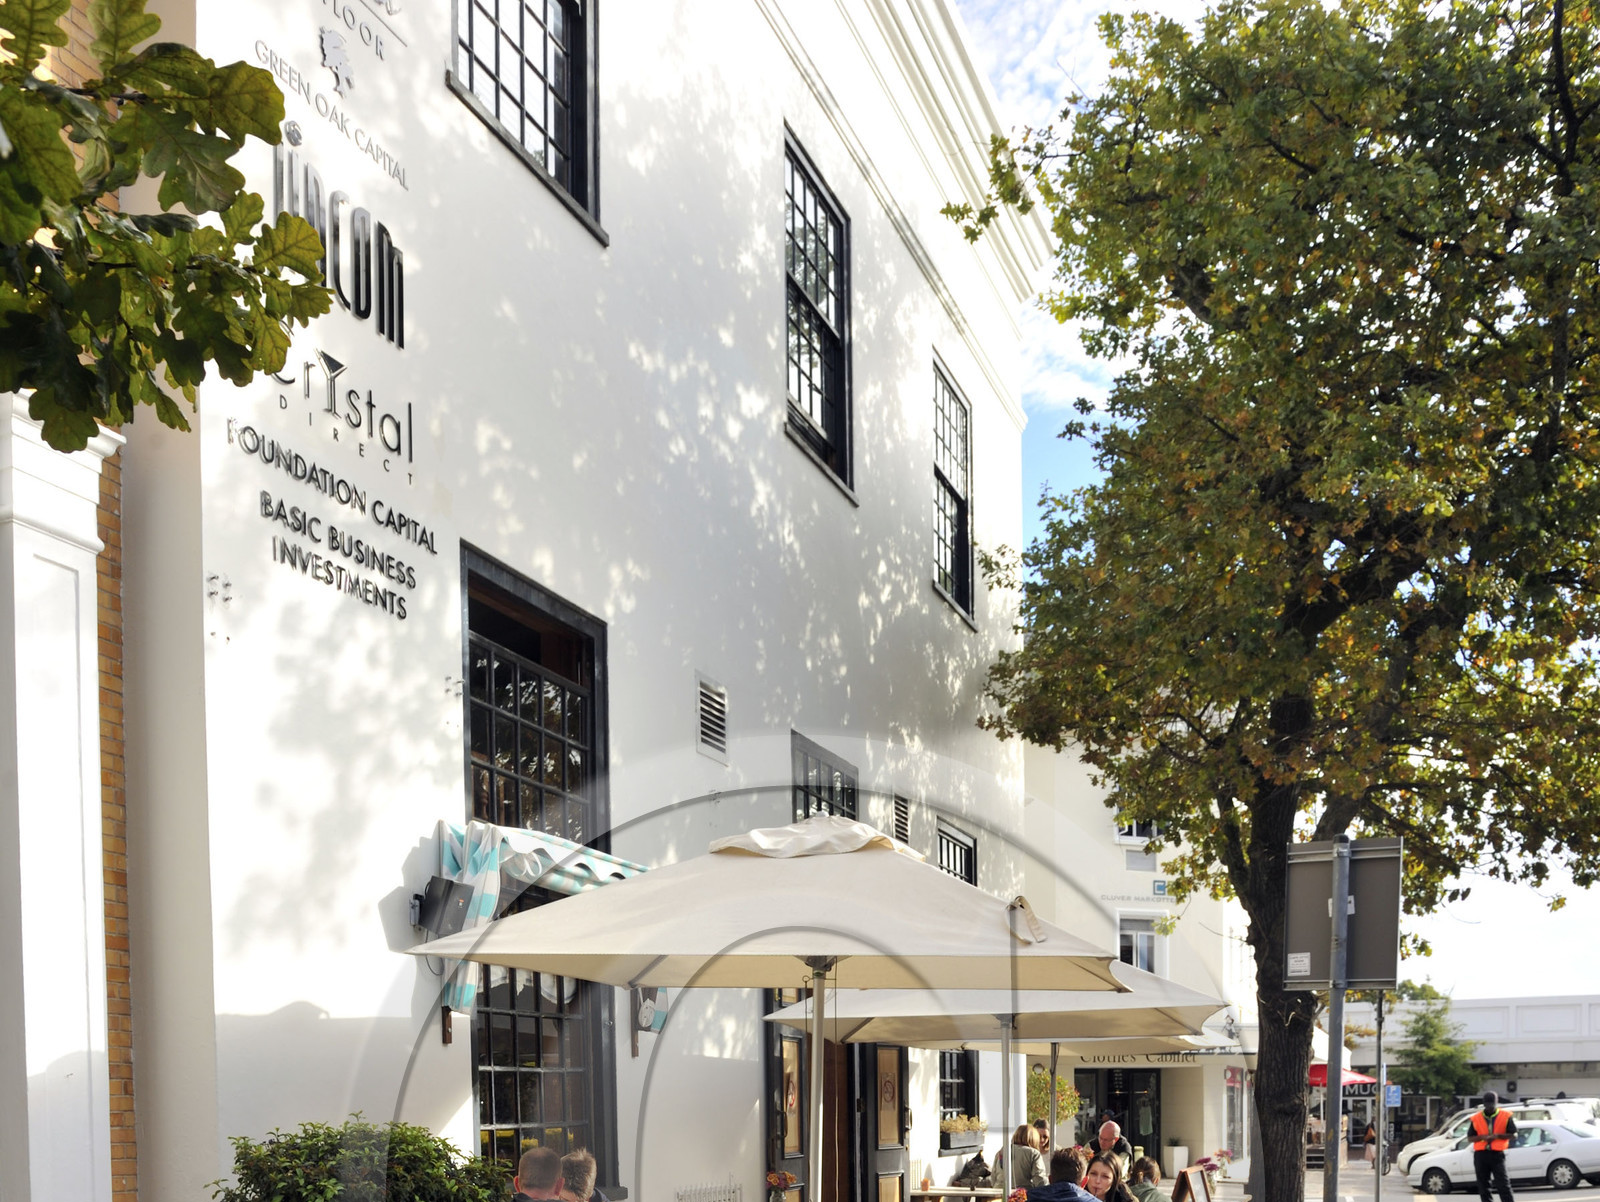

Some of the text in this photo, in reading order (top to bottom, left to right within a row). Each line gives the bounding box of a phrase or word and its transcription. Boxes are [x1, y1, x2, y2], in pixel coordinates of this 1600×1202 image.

[322, 0, 384, 61] LOOR
[255, 40, 408, 191] GREEN OAK CAPITAL
[279, 394, 413, 485] DIRECT
[226, 416, 437, 555] FOUNDATION CAPITAL
[260, 490, 416, 590] BASIC BUSINESS
[272, 535, 407, 620] INVESTMENTS
[1134, 895, 1176, 904] MARKOTTE
